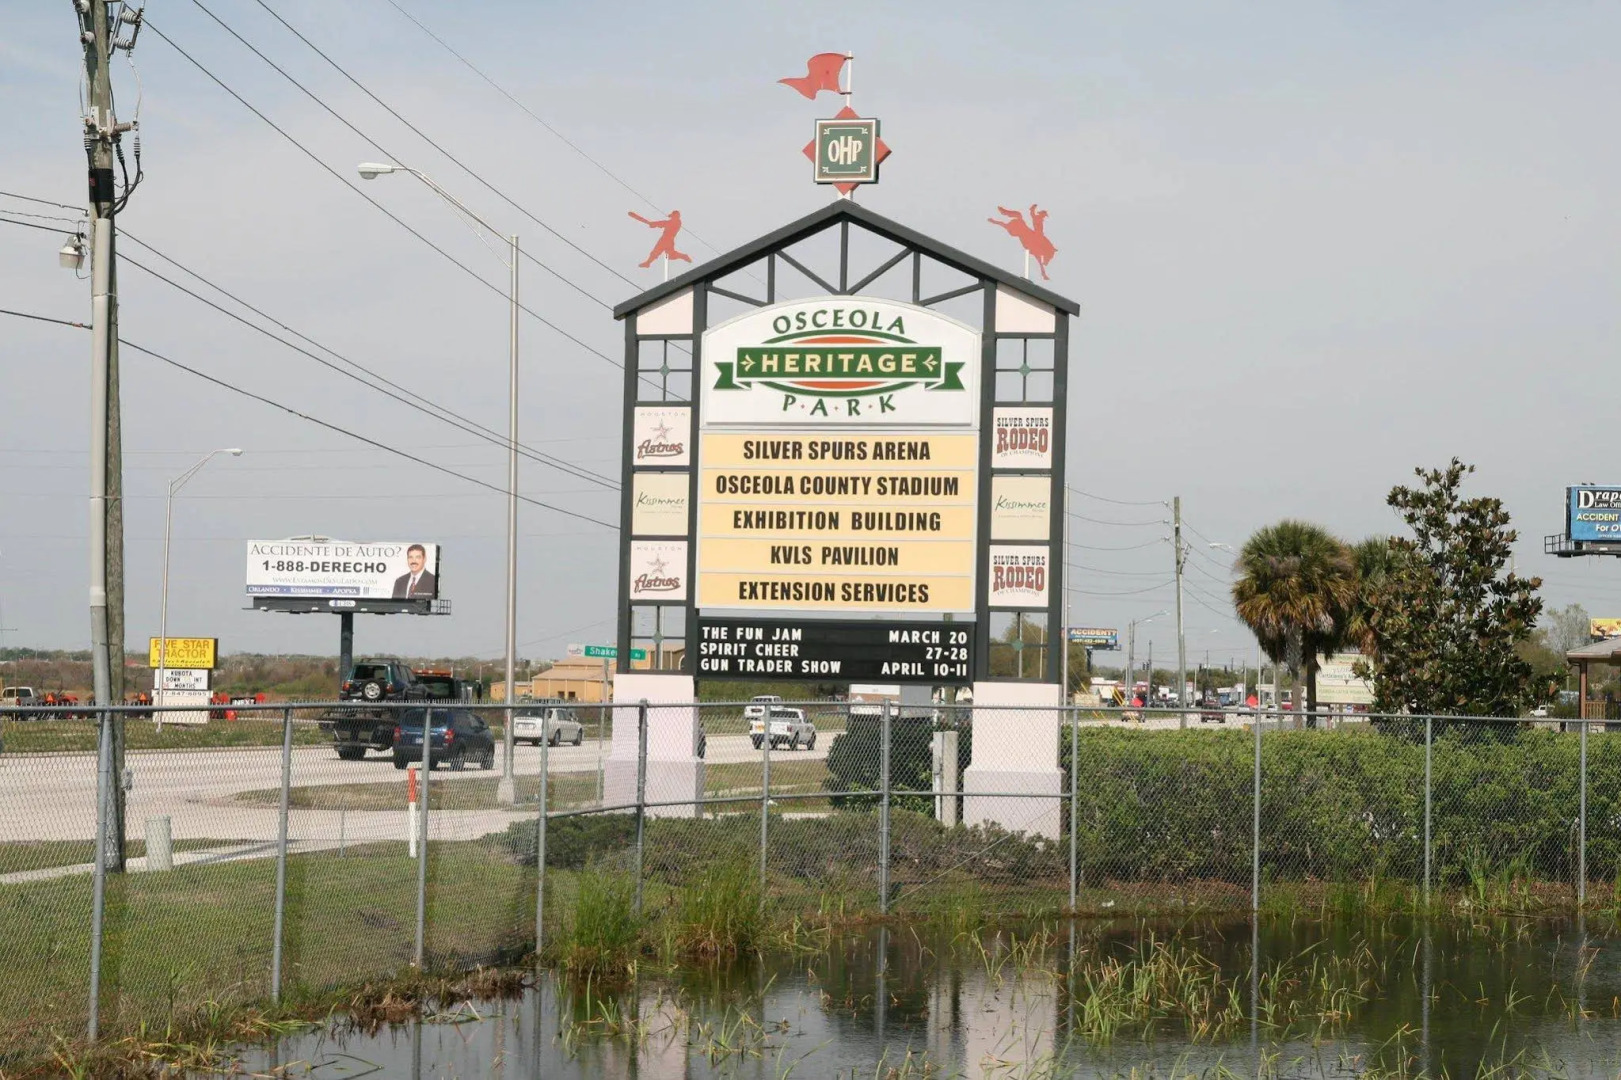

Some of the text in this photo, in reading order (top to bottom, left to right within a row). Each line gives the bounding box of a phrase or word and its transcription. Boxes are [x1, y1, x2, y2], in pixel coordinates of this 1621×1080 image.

[828, 136, 863, 165] OHP
[772, 309, 905, 335] OSCEOLA
[761, 353, 917, 373] HERITAGE
[997, 417, 1049, 427] SILVER SPURS
[637, 439, 684, 459] Astros
[996, 428, 1048, 454] RODEO
[743, 441, 931, 461] SILVER SPURS ARENA
[716, 475, 959, 496] OSCEOLA COUNTY STADIUM
[636, 491, 685, 508] Kissimmee
[994, 494, 1046, 511] Kissimmee
[1579, 490, 1621, 508] Drap
[733, 511, 941, 531] EXHIBITION BUILDING
[1576, 512, 1620, 521] ACCIDENT
[1611, 524, 1621, 532] O
[250, 544, 402, 558] ACCIDENTE DE AUTO?
[770, 546, 899, 566] KVLS PAVILION
[993, 555, 1046, 566] SILVER SPURS
[262, 560, 387, 574] 1-888-DERECHO
[634, 573, 681, 593] Astros
[993, 566, 1045, 592] RODEO
[739, 581, 929, 603] EXTENSION SERVICES
[154, 640, 210, 649] FVE STAR
[702, 626, 968, 644] THE FUN JAM MARCH 20
[700, 642, 968, 661] SPIRIT CHEER 27-28
[700, 658, 967, 676] GUN TRADER SHOW APRIL 10-11
